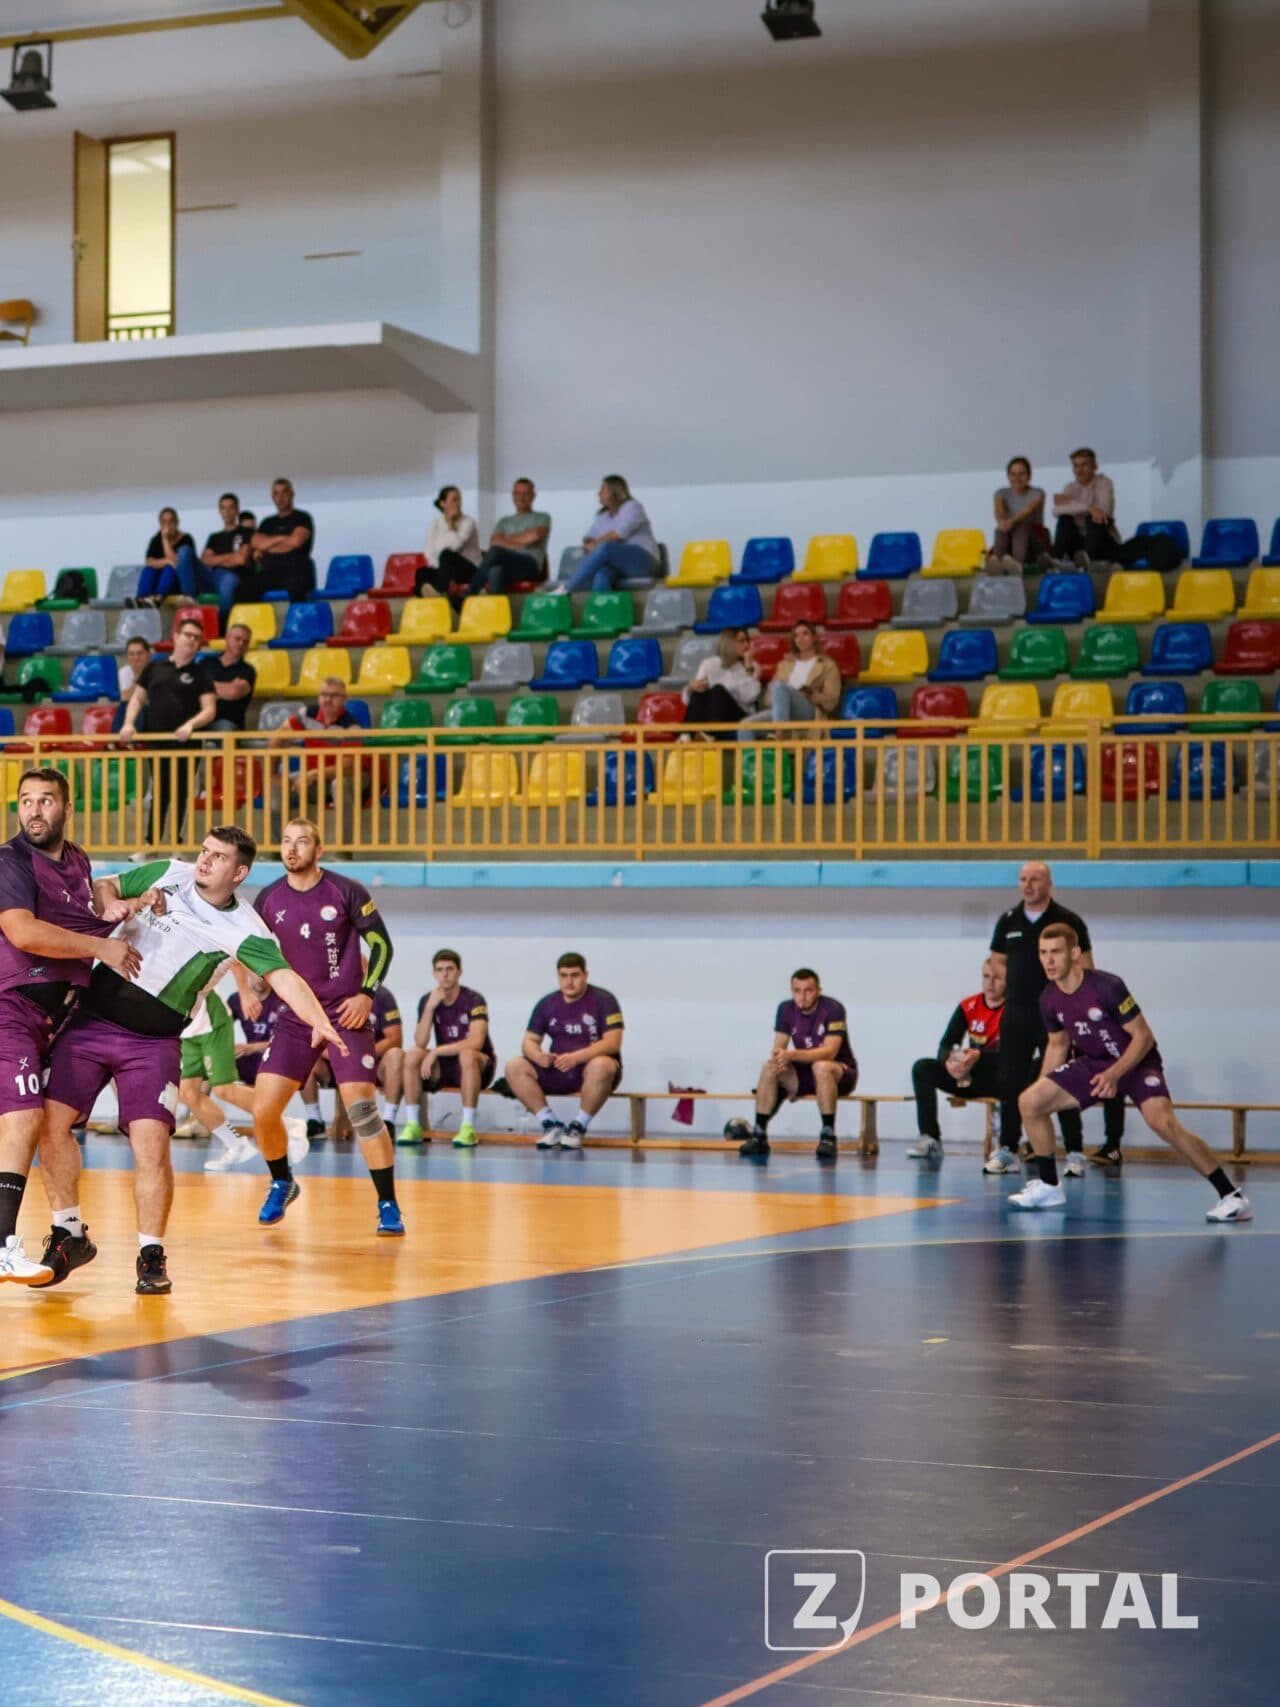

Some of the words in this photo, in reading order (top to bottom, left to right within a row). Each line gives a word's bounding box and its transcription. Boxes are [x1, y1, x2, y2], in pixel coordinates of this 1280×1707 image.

[299, 922, 311, 939] 4
[325, 932, 336, 946] RK
[14, 1073, 40, 1096] 10
